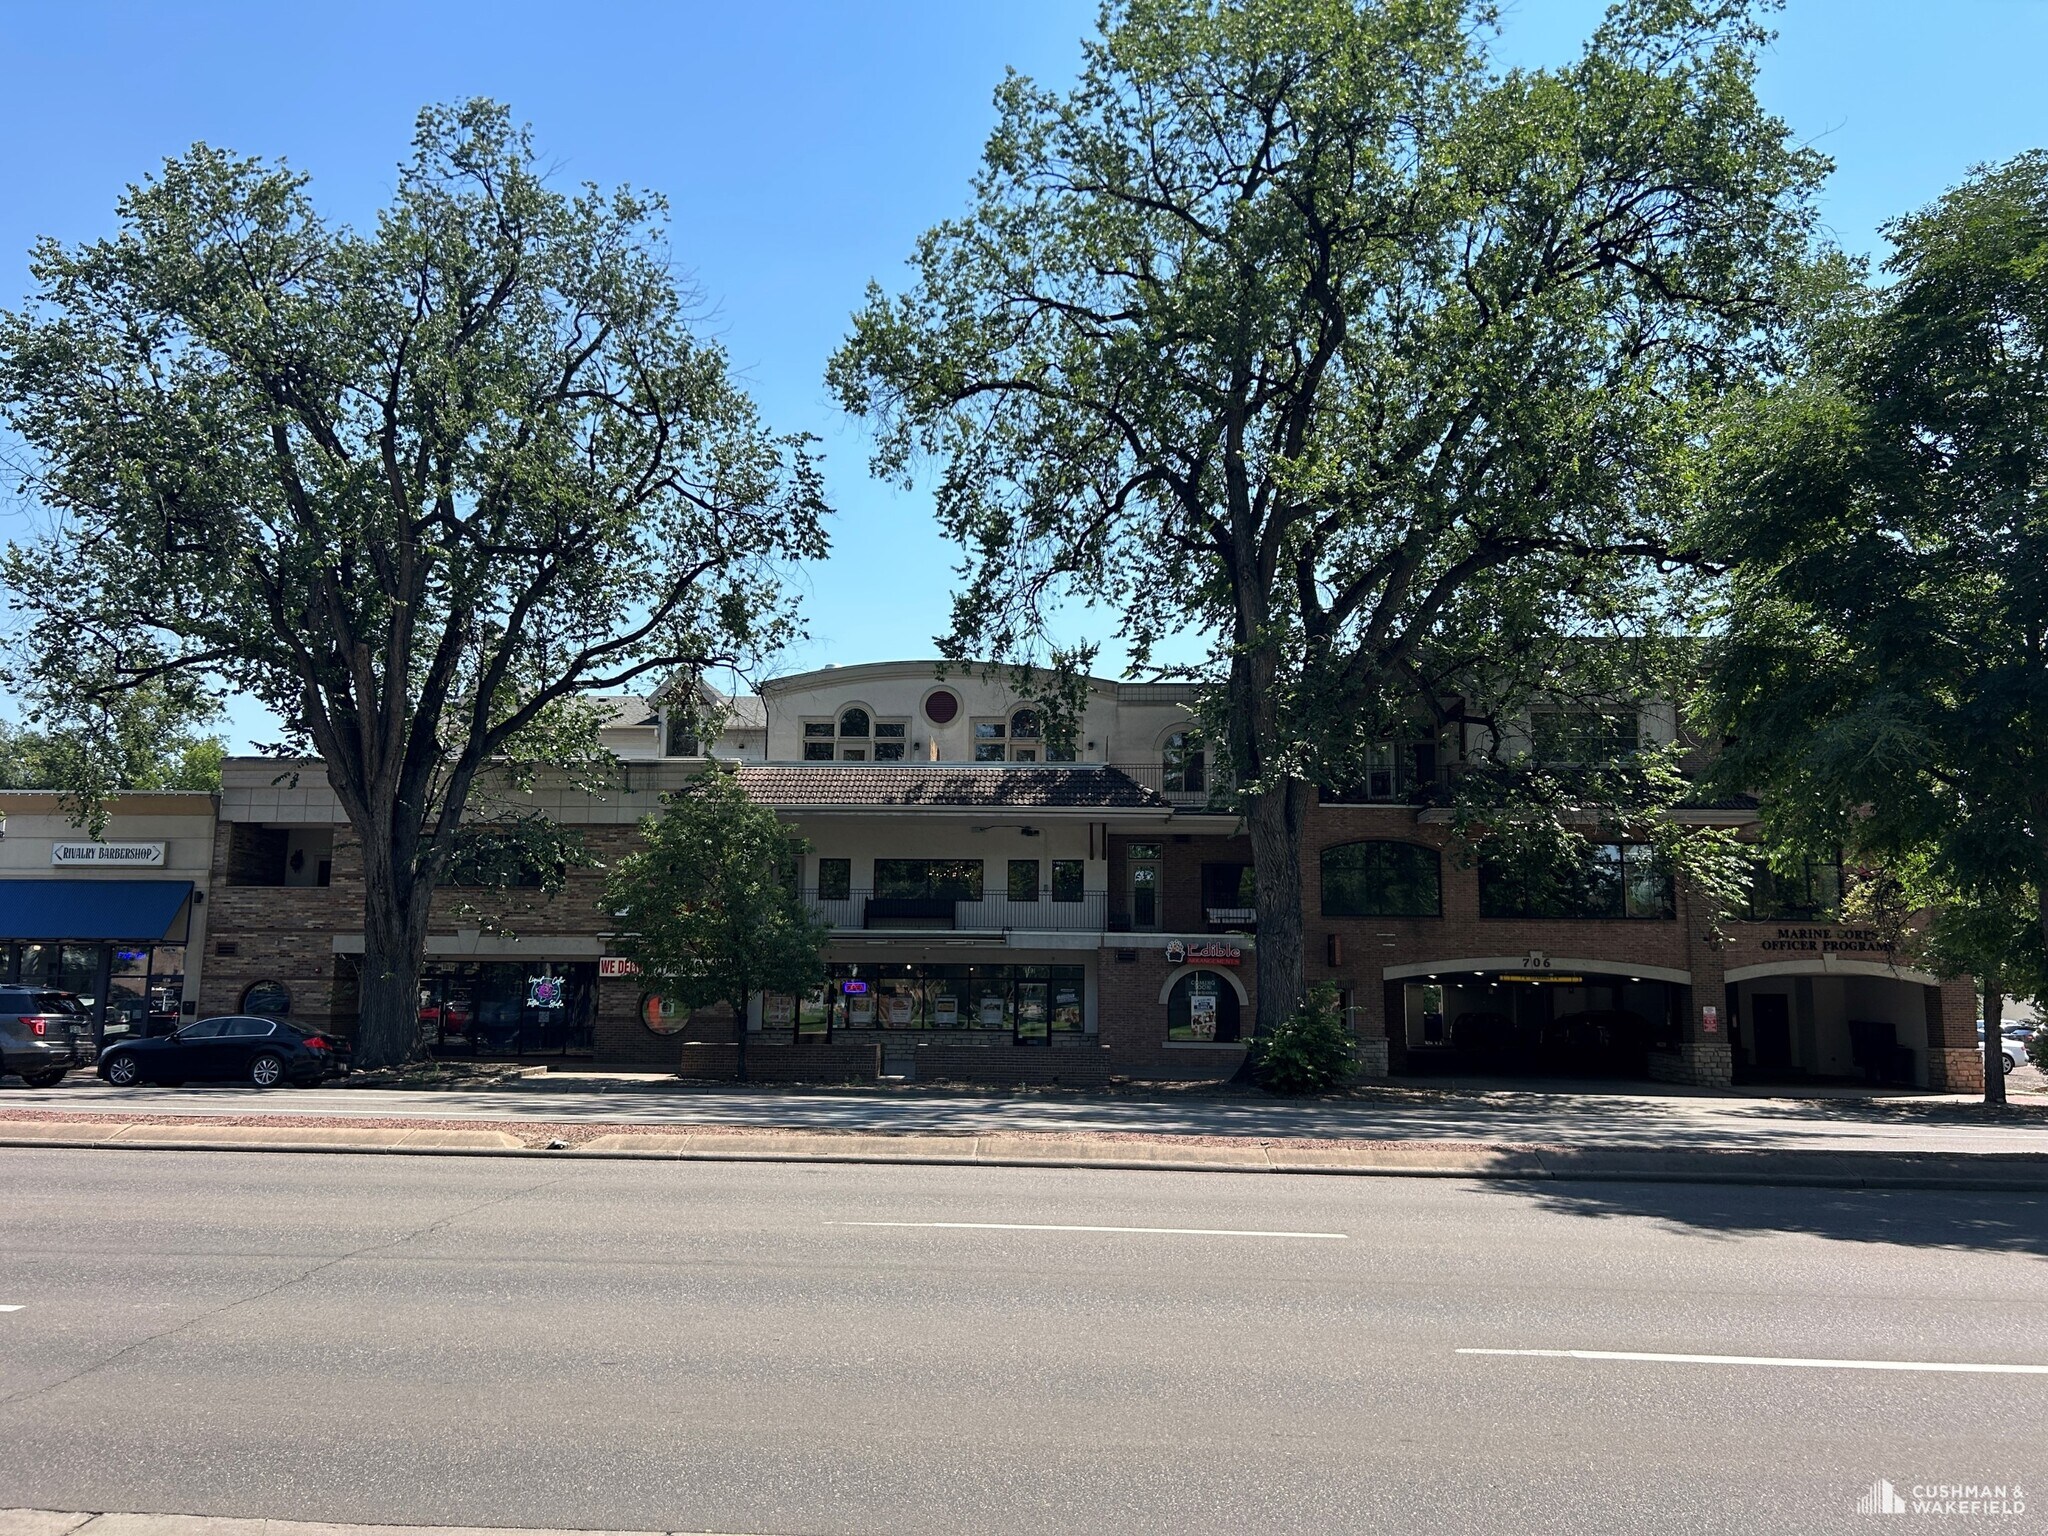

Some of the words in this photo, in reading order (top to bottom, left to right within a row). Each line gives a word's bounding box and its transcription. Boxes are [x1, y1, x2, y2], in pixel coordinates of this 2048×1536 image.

[63, 847, 96, 859] RIVALRY
[98, 847, 152, 860] BARBERSHOP
[1778, 929, 1831, 939] MARINE
[1187, 942, 1240, 957] Edible
[1762, 940, 1817, 950] OFFICER
[601, 960, 615, 973] WE
[1522, 958, 1551, 968] 706
